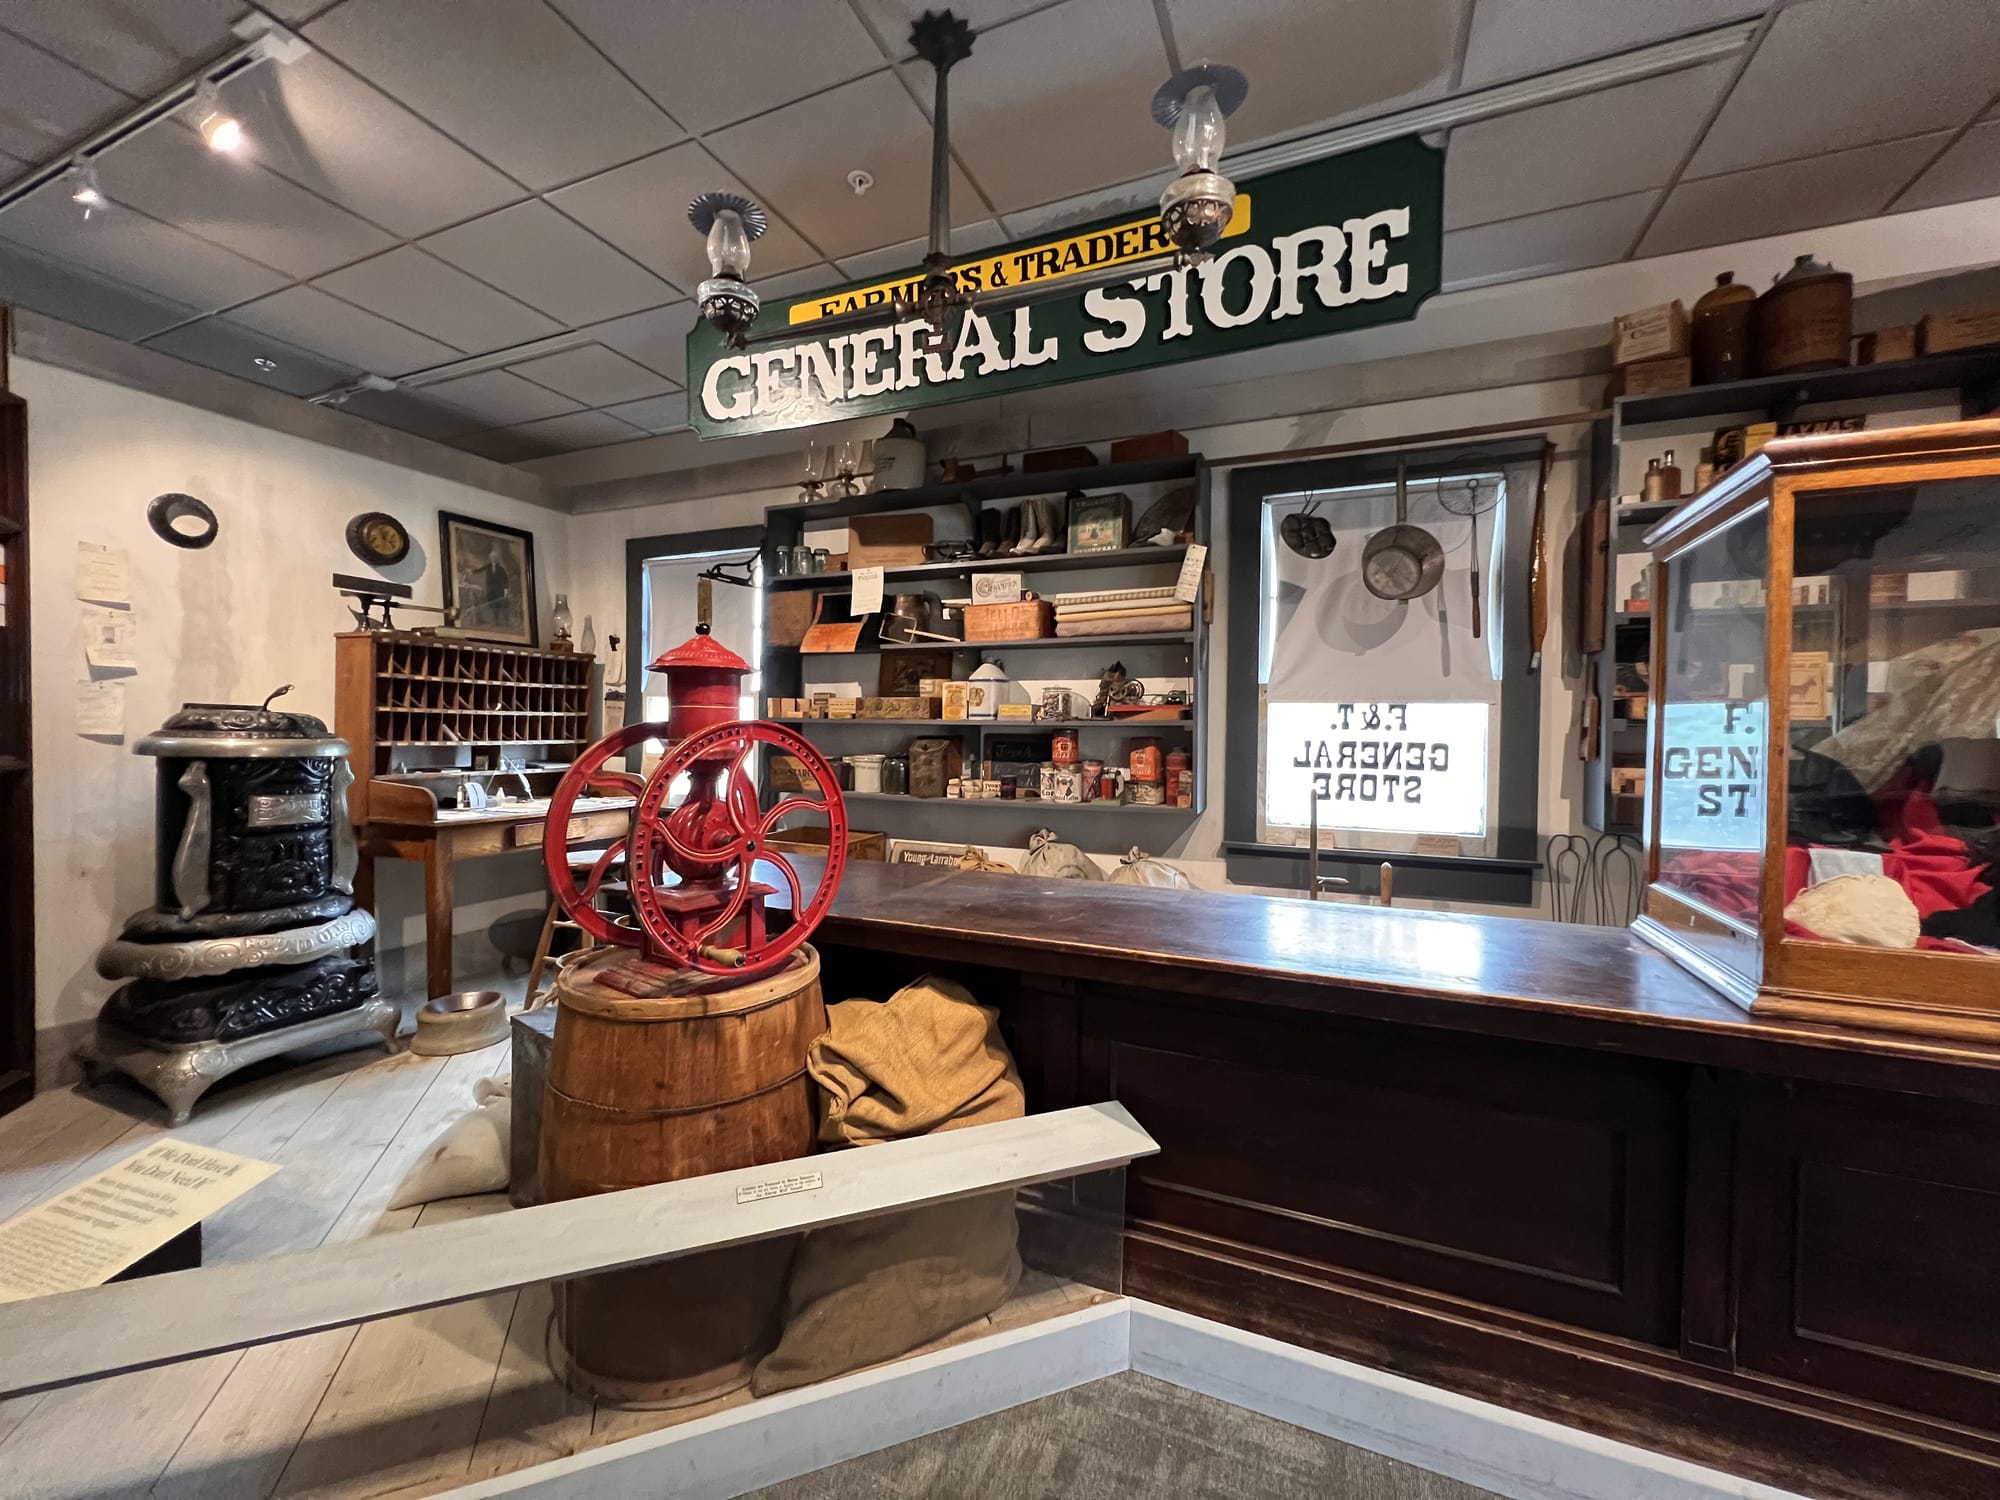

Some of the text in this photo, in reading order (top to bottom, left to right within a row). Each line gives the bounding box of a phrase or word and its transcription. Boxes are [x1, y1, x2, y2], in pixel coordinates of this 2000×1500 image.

[991, 261, 1008, 287] &
[1014, 221, 1170, 282] TRADER
[701, 206, 1411, 421] GENERAL STORE
[904, 851, 927, 866] Young
